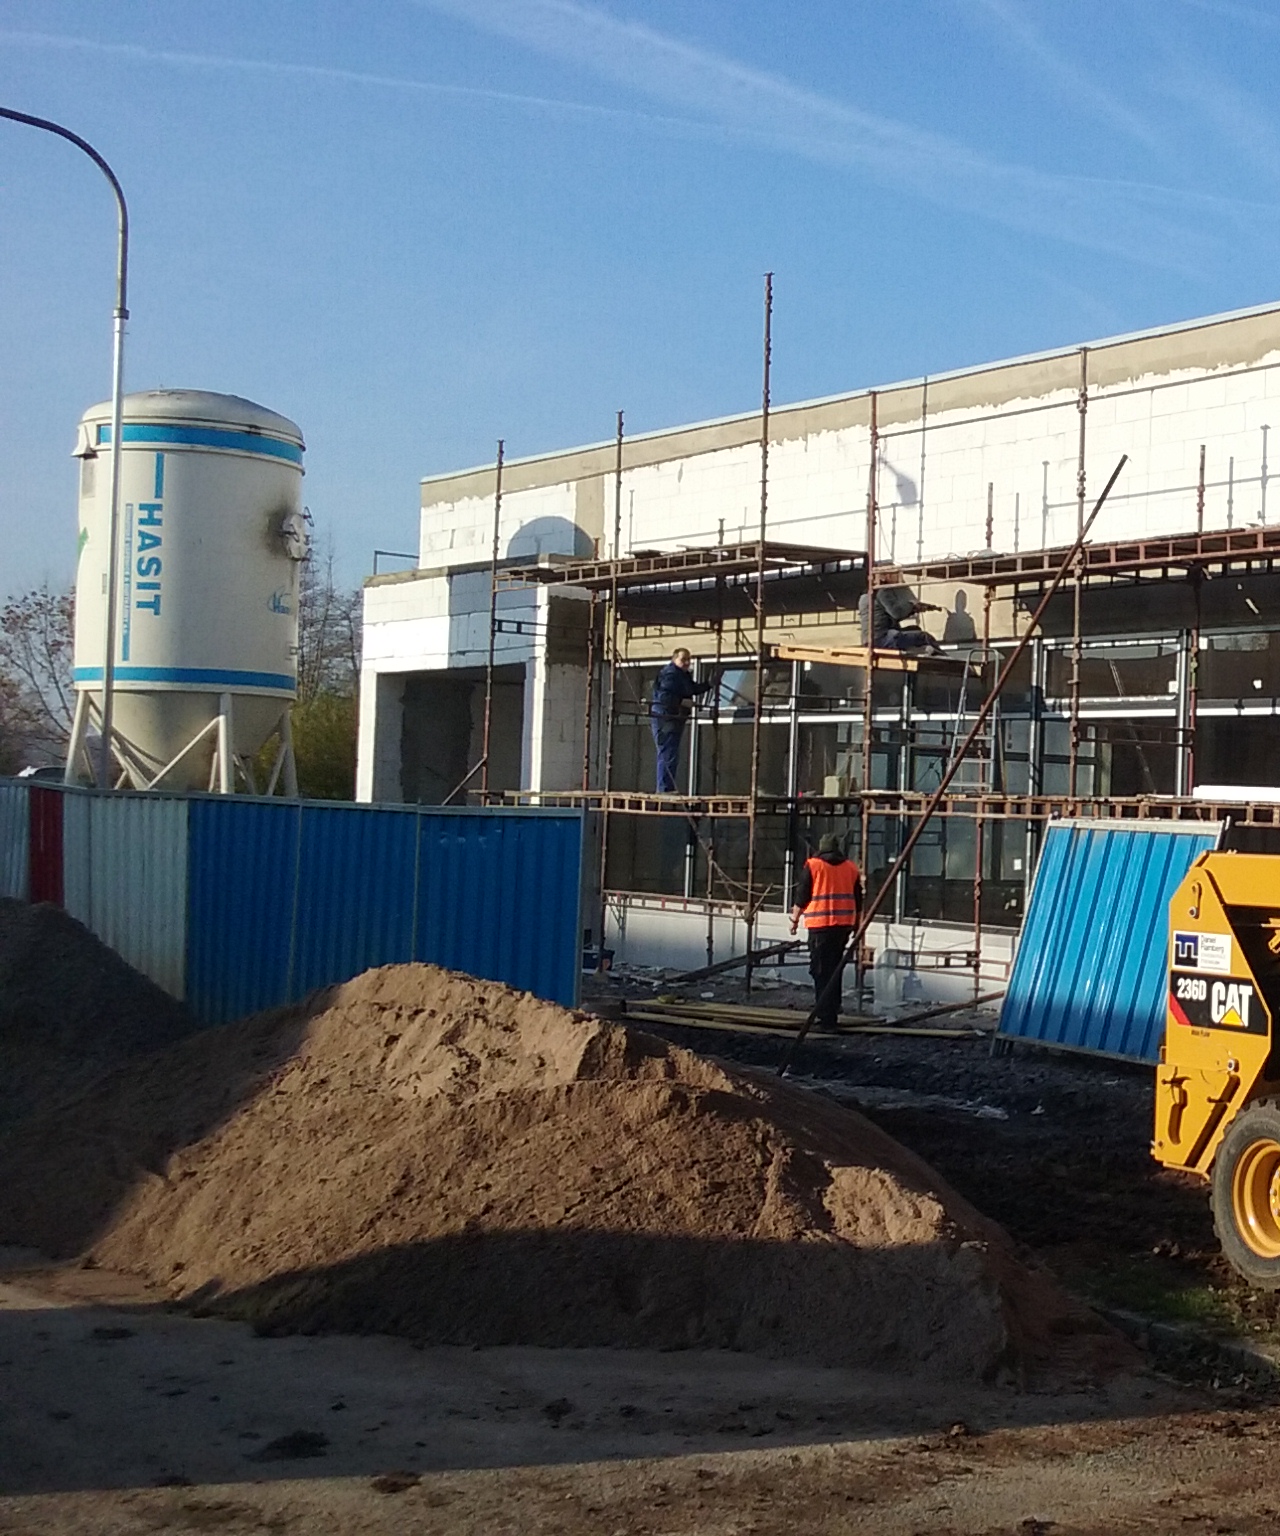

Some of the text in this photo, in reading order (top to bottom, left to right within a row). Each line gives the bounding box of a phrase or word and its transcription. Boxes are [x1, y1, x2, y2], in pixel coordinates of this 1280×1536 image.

[136, 503, 163, 616] HASIT
[1177, 977, 1253, 1028] 236D CAT
